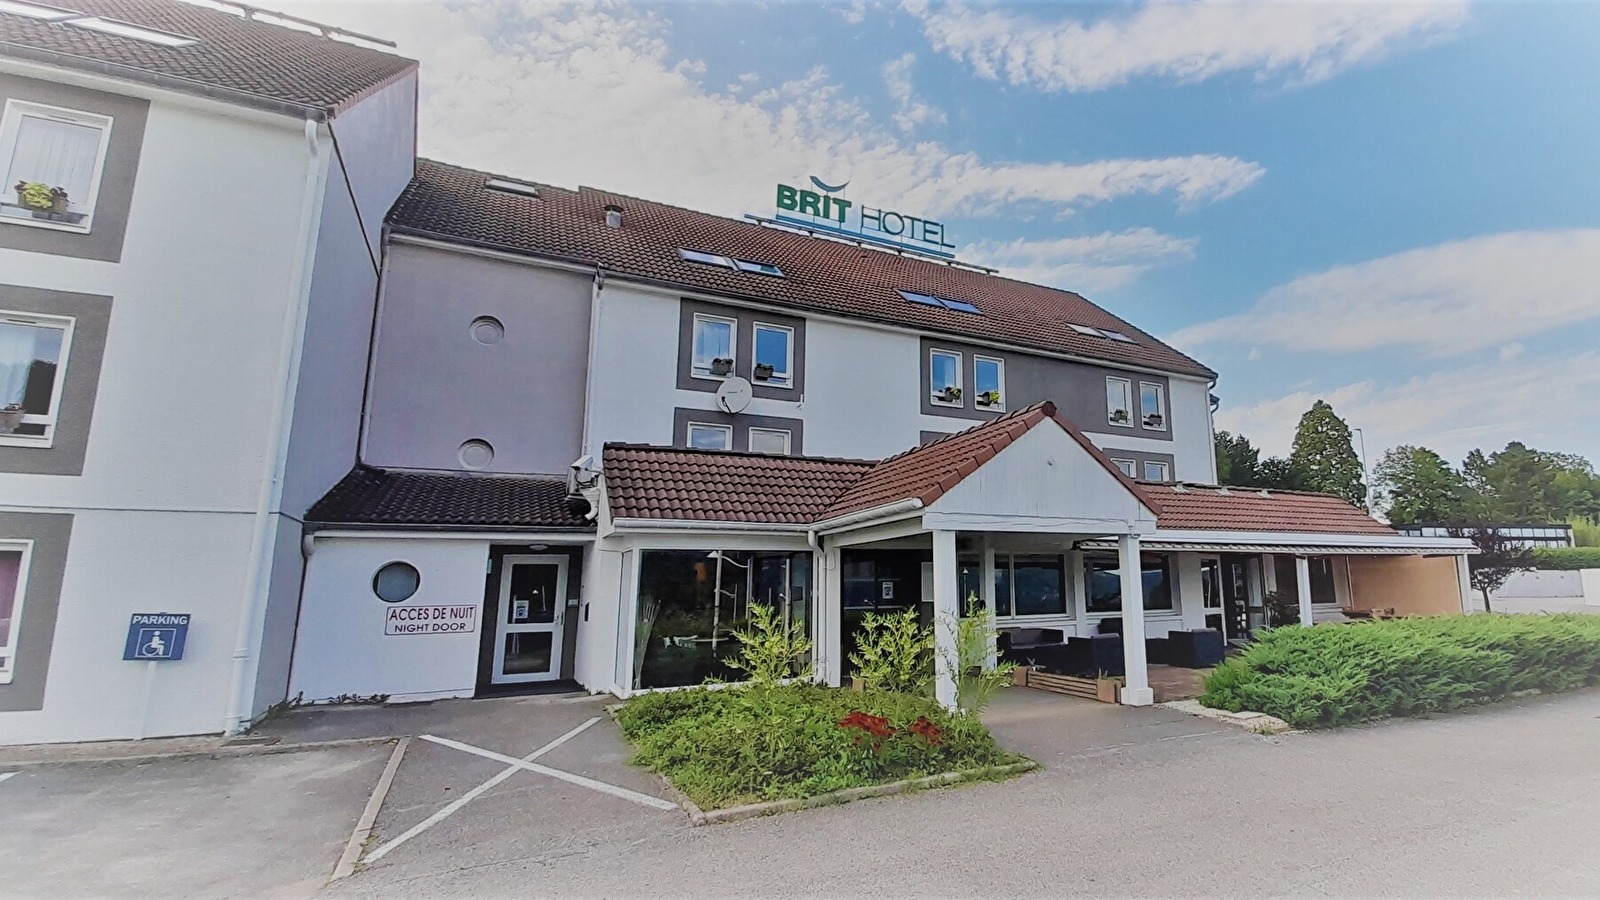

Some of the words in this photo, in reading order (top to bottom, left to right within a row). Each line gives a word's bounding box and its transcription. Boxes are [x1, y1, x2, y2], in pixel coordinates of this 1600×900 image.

[776, 183, 852, 223] BRIT
[861, 205, 955, 248] HOTEL
[389, 608, 430, 620] ACCES
[432, 608, 447, 620] DE
[450, 607, 475, 619] NUIT
[132, 615, 188, 625] PARKING
[394, 623, 430, 633] NIGHT
[432, 622, 467, 632] DOOR
